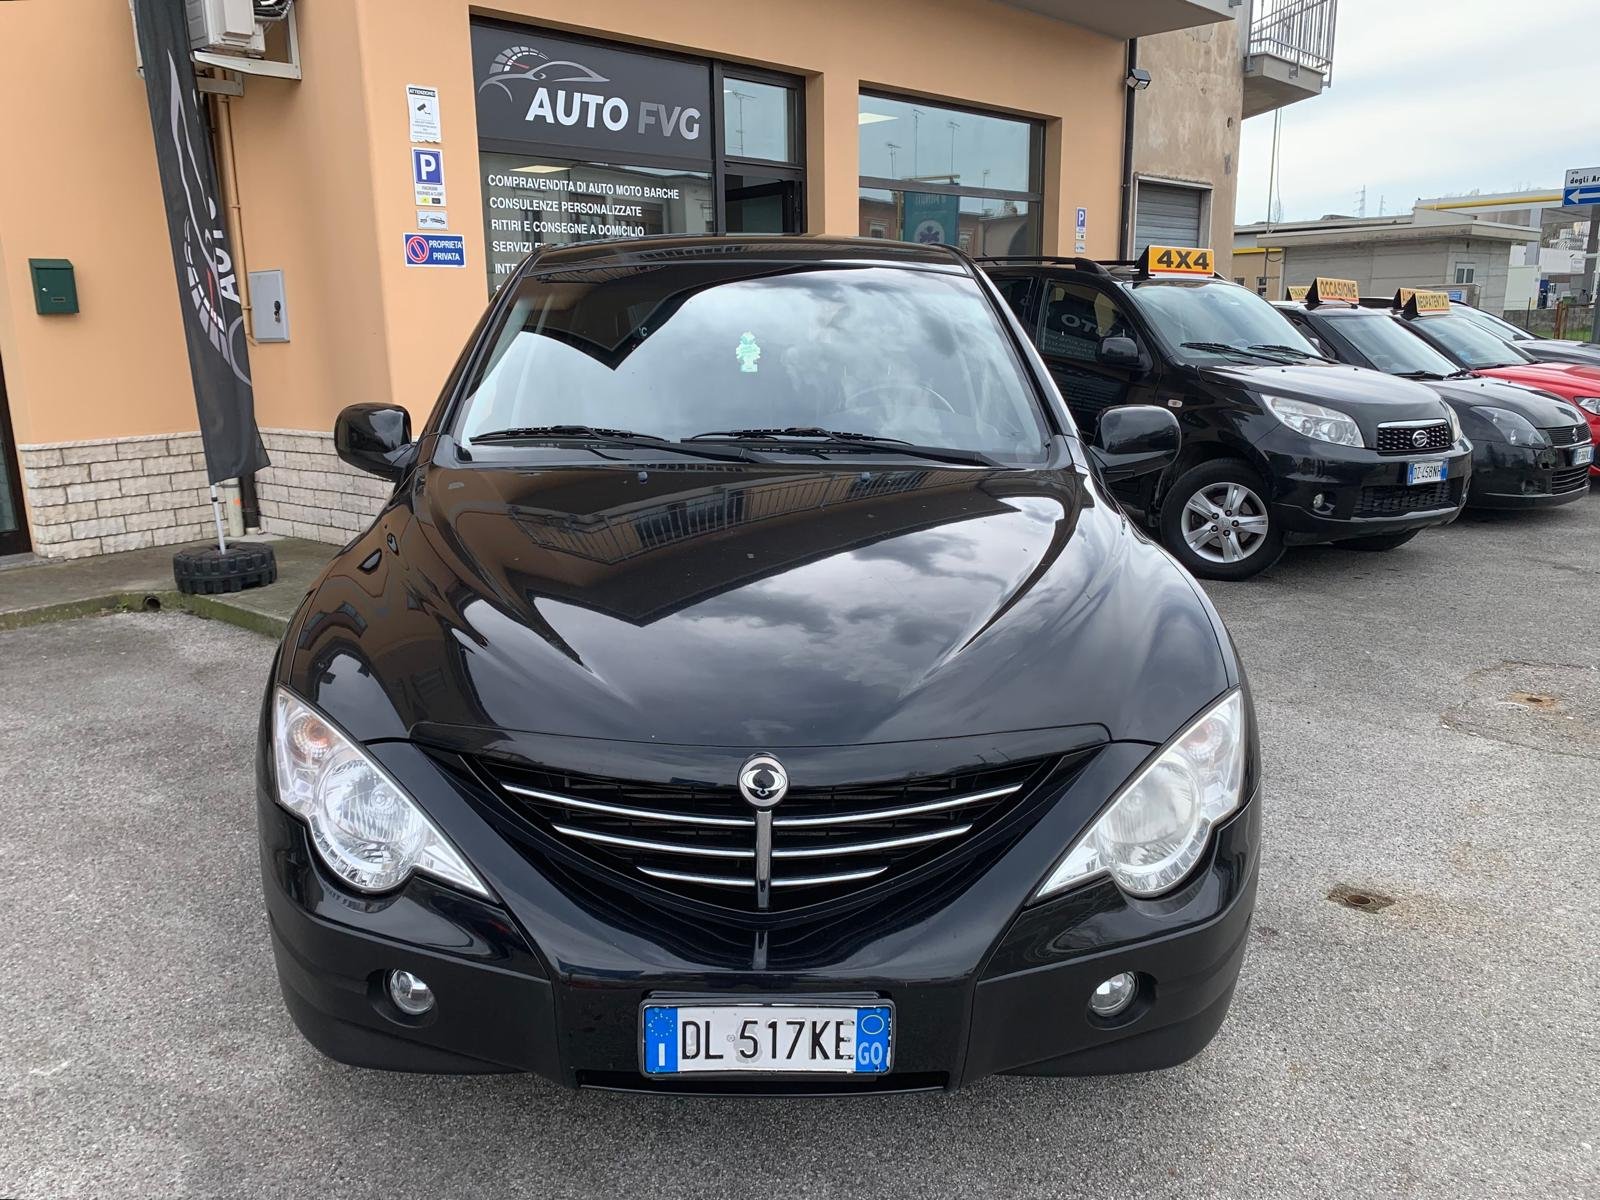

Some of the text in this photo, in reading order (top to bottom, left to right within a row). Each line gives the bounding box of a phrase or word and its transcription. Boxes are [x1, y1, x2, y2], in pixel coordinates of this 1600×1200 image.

[525, 87, 701, 140] AUTO FVG
[420, 154, 436, 180] P
[488, 175, 680, 199] COMPRAVENDITA DI AUTO MOTO BARCHE
[1570, 176, 1589, 184] degli
[489, 197, 642, 216] CONSULENZE PERSONALIZZATE
[1078, 211, 1085, 225] P
[491, 219, 645, 237] RITIRI E CONSEGNE A DOMICILIO
[492, 240, 533, 252] SERVIZI
[433, 252, 460, 261] PRIVATA
[1157, 250, 1209, 270] 4X4
[1320, 280, 1357, 298] OCCASIONE
[681, 1019, 855, 1060] DL 517KE
[857, 1041, 884, 1066] GO
